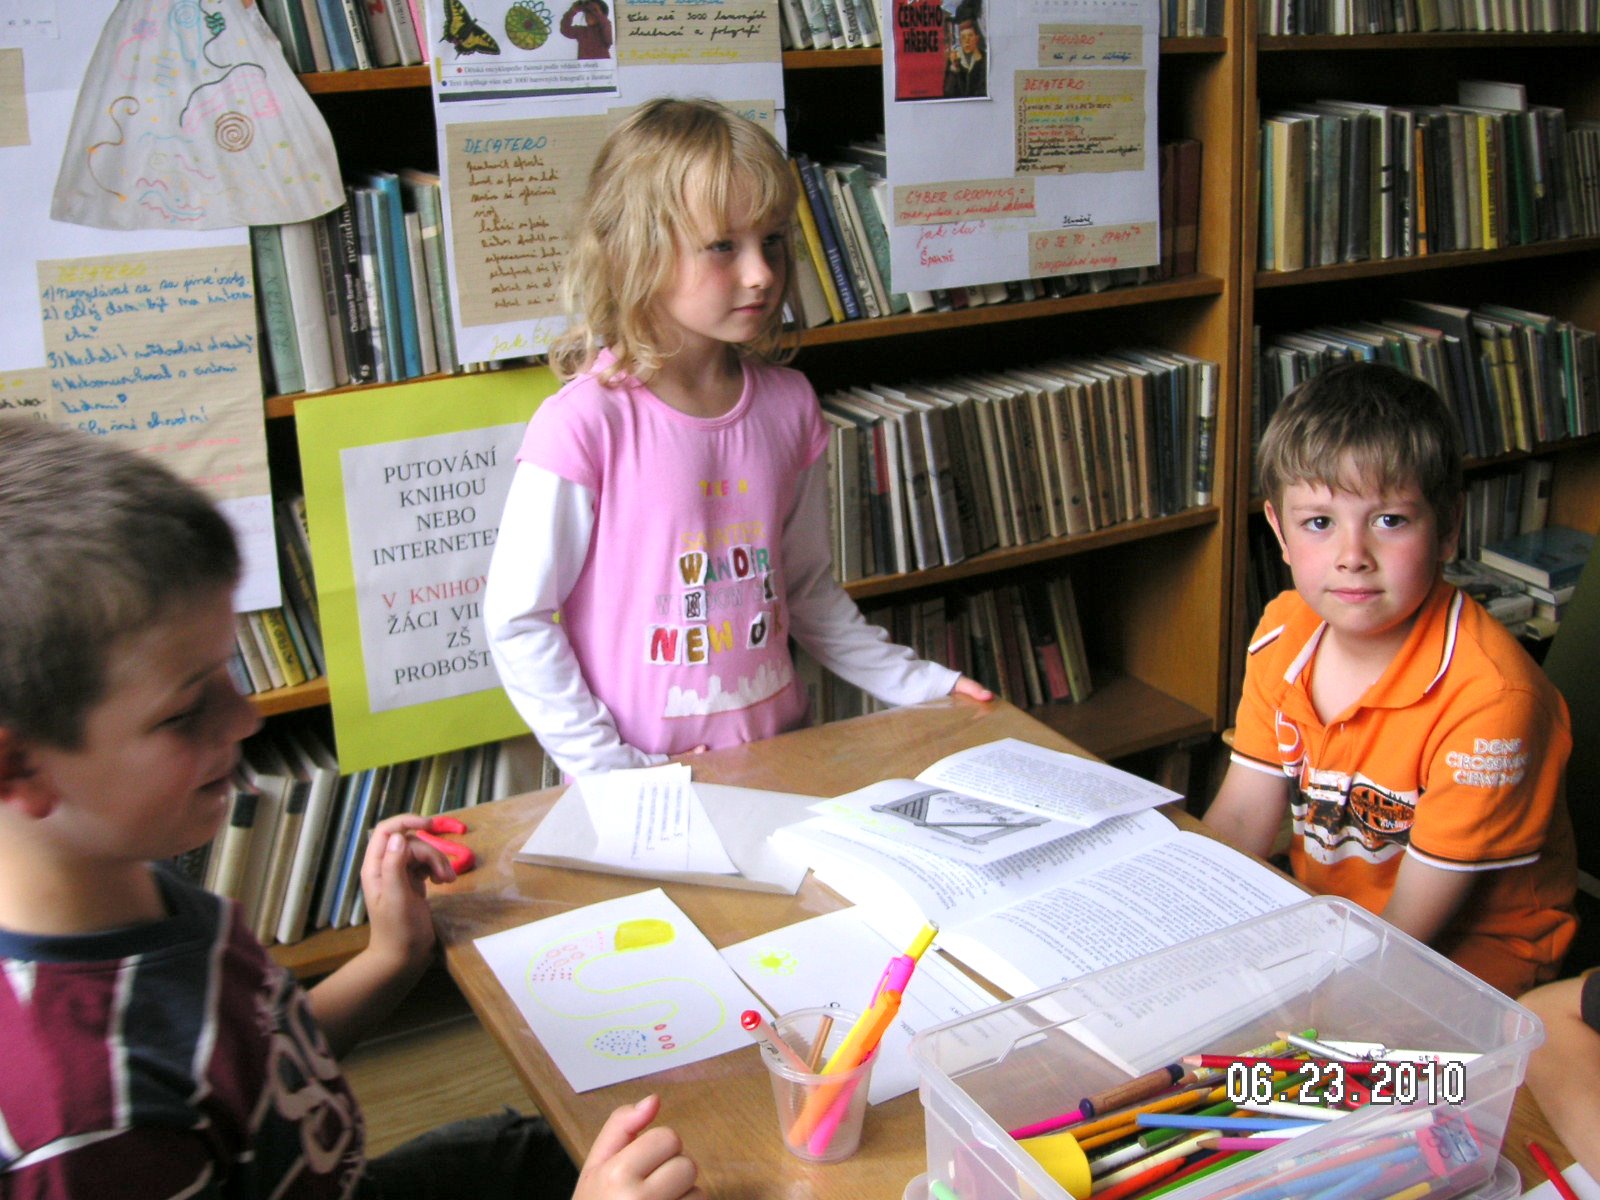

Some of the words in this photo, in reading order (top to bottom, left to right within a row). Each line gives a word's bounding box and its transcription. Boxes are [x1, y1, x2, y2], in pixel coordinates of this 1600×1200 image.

[384, 445, 498, 484] PUTOVÁNÍ
[399, 478, 487, 508] KNIHOU
[416, 506, 476, 532] NEBO
[374, 528, 500, 566] INTERNETE
[680, 547, 771, 586] WANDR
[382, 592, 397, 609] V
[388, 611, 439, 635] ŽÁCI
[446, 626, 472, 650] ZŠ
[650, 620, 735, 663] NEW
